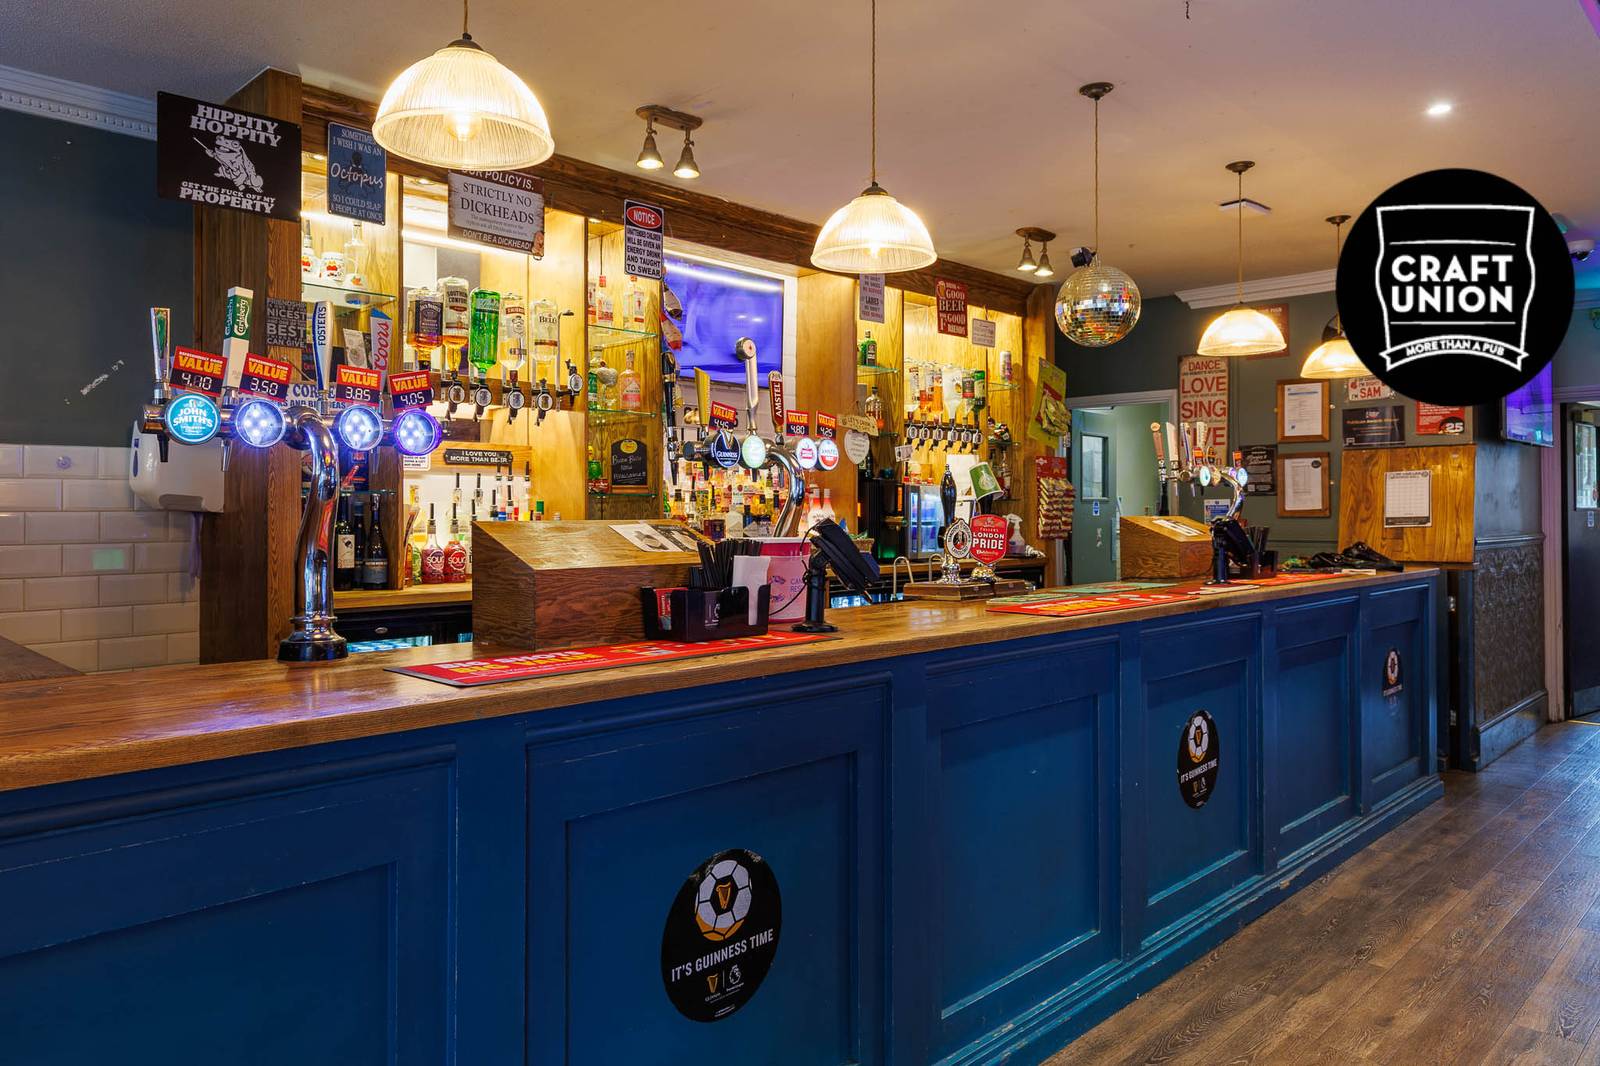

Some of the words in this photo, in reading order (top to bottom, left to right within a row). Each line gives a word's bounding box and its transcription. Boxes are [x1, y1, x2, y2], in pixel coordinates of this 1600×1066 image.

[197, 104, 278, 134] HIPPITY
[190, 115, 281, 147] HOPPITY
[342, 129, 375, 143] SOMETIME
[337, 138, 352, 149] WISH
[357, 142, 371, 154] WAS
[373, 146, 382, 156] AN
[331, 163, 383, 188] Octopus
[485, 171, 521, 186] POLICY
[181, 181, 198, 190] GET
[201, 184, 219, 193] THE
[221, 187, 244, 197] FUCK
[463, 182, 514, 203] STRICTLY
[516, 195, 532, 208] NO
[180, 187, 274, 214] PROPERTY
[344, 196, 366, 208] COULD
[366, 201, 382, 211] SLAP
[335, 205, 357, 215] PEOPLE
[357, 209, 366, 217] AT
[461, 197, 534, 225] DICKHEADS
[633, 210, 655, 225] NOTICE
[463, 229, 482, 240] DON'T
[483, 234, 492, 242] BE
[627, 245, 645, 256] ENERGY
[647, 249, 660, 258] DRINK
[643, 240, 655, 249] GIVEN
[655, 242, 660, 250] AN
[627, 255, 638, 263] AND
[640, 257, 660, 268] TAUGHT
[627, 264, 636, 272] TO
[637, 265, 660, 277] SWEAR
[946, 289, 965, 300] GOOD
[940, 299, 964, 311] BEER
[234, 299, 249, 336] Carlsberg
[267, 308, 306, 319] NICEST
[947, 313, 965, 325] GOOD
[267, 323, 305, 338] BEST
[286, 340, 305, 348] GIVE
[374, 321, 390, 370] Coors
[178, 355, 223, 374] VALUE
[249, 362, 287, 380] VALUE
[1189, 360, 1220, 371] DANCE
[250, 378, 278, 396] 3.50
[341, 372, 378, 387] VALUE
[393, 378, 428, 391] VALUE
[1182, 375, 1227, 394] LOVE
[345, 386, 371, 401] 3.85
[400, 391, 425, 406] 4.05
[774, 382, 782, 417] AMSTEL
[1360, 386, 1381, 398] SAM
[178, 408, 207, 418] JOHN
[713, 407, 735, 420] VALUE
[1181, 400, 1227, 419] SING
[173, 416, 213, 427] SMITH'S
[788, 415, 808, 424] VALUE
[818, 416, 836, 428] VALUE
[1446, 422, 1463, 432] 25
[972, 538, 1004, 550] PRIDE
[449, 663, 508, 674] BIG
[511, 653, 602, 666] VALUE
[671, 961, 692, 982] IT'S
[695, 939, 747, 972] GUINNESS
[750, 928, 774, 949] TIME
